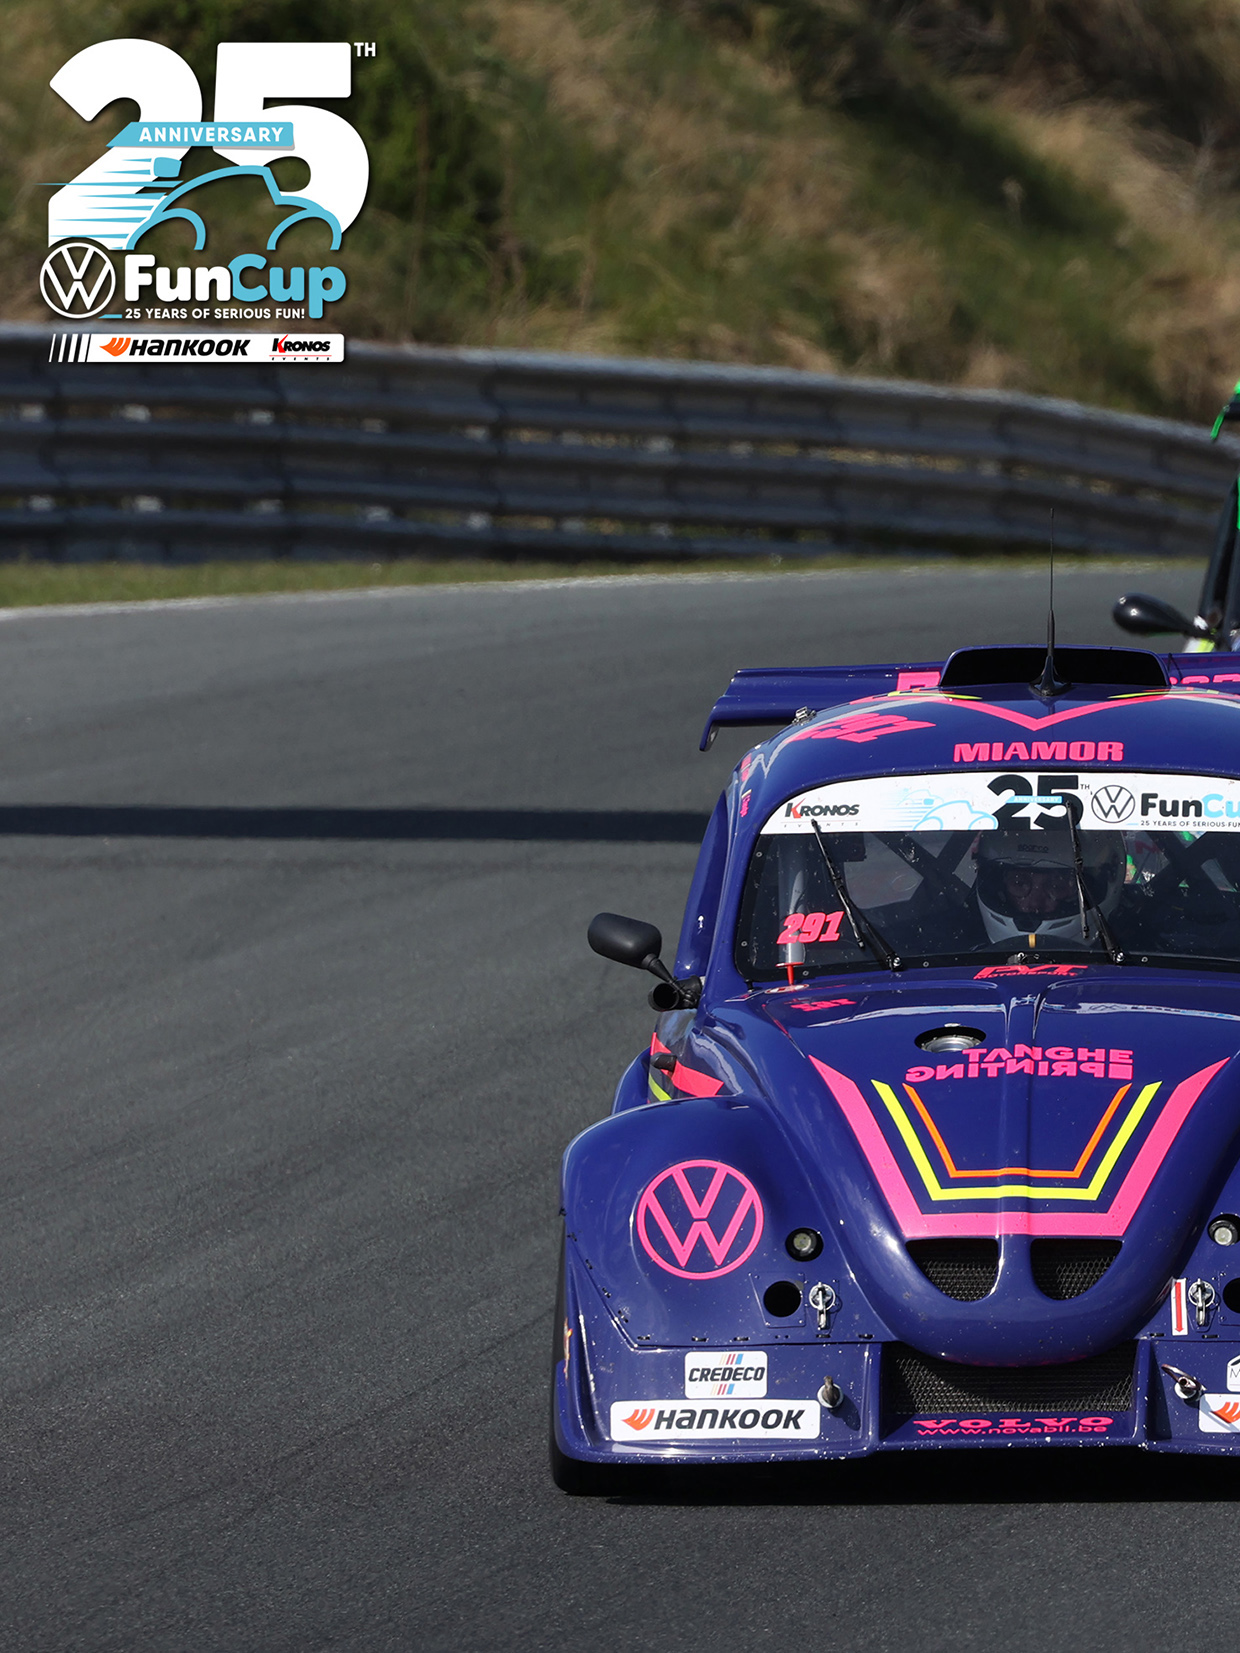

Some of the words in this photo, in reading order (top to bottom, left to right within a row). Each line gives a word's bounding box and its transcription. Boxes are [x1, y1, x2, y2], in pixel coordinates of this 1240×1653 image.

[953, 741, 1125, 763] MIAMOR
[785, 798, 860, 818] KRONOS
[987, 774, 1084, 831] 25
[776, 911, 845, 945] 291
[962, 1043, 1134, 1064] TANGHE
[688, 1366, 766, 1382] CREDECO
[913, 1416, 1114, 1429] VOLVO
